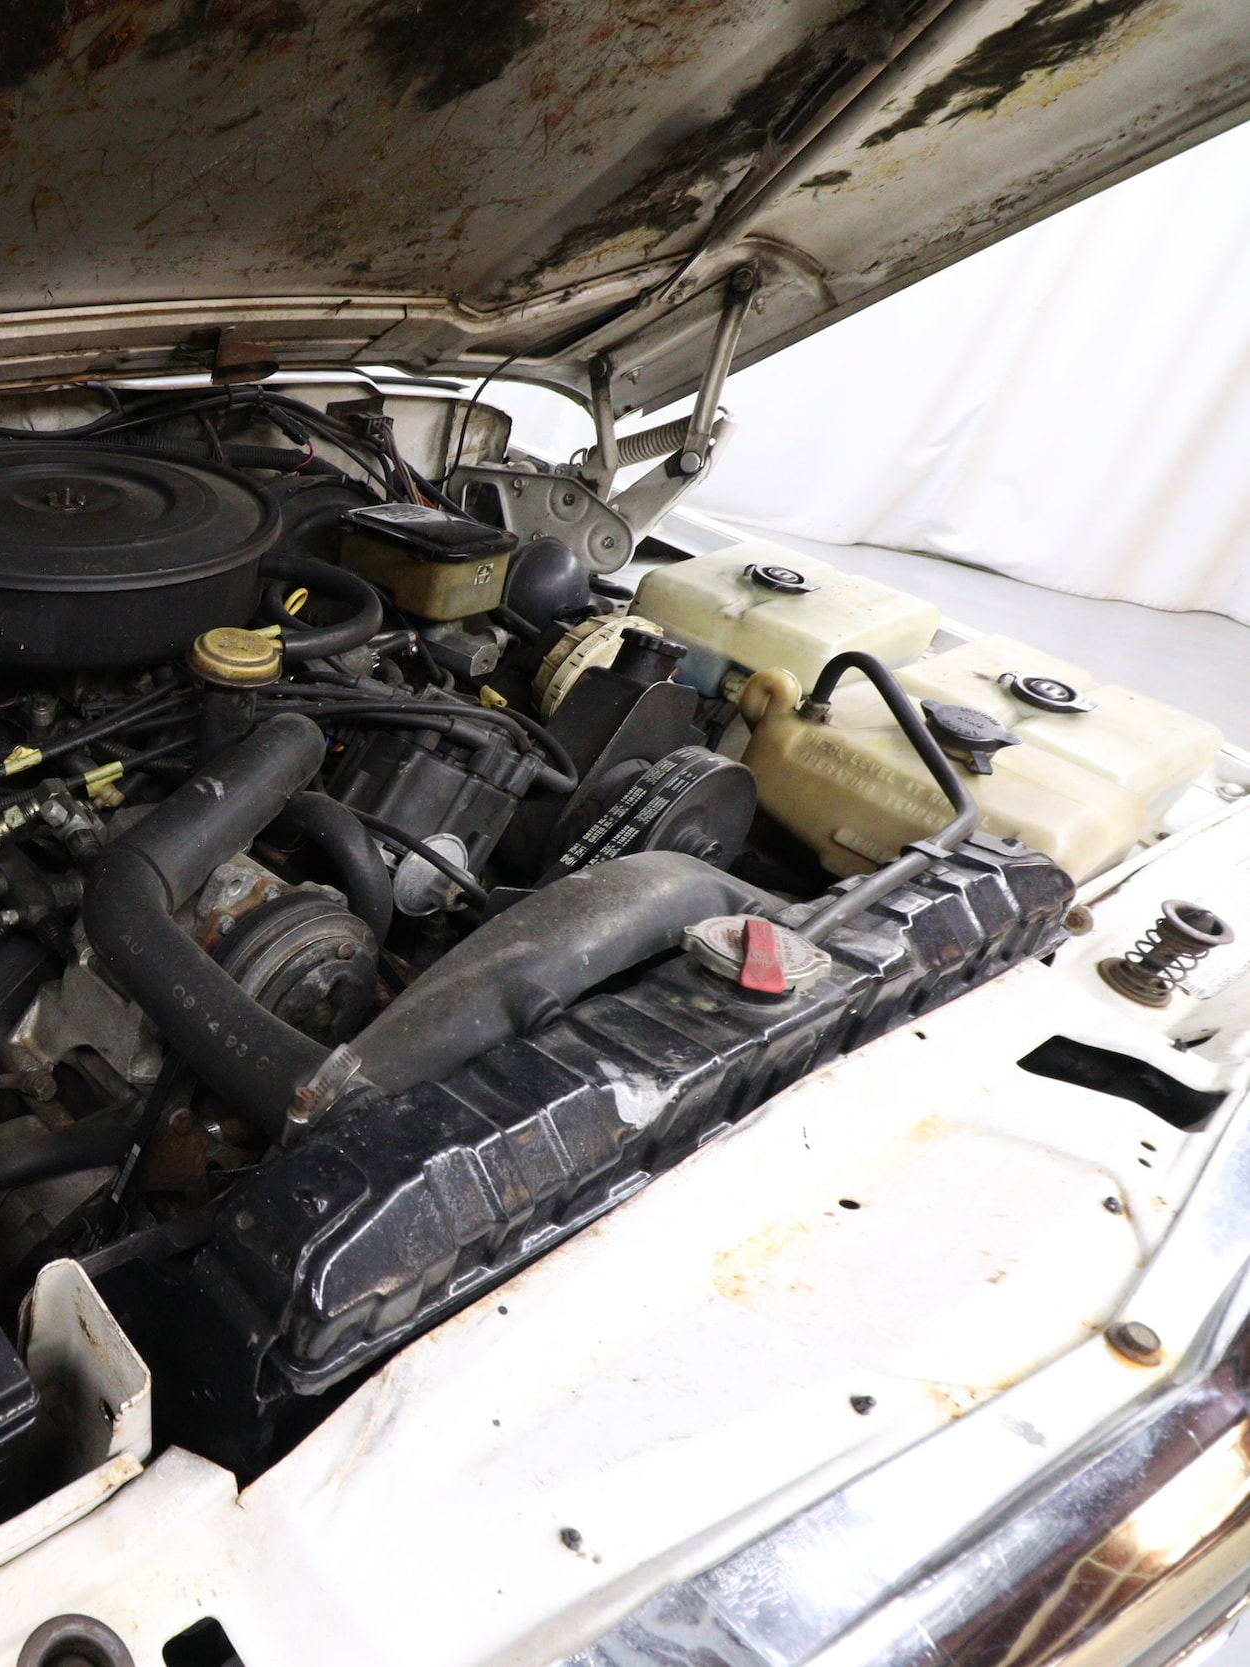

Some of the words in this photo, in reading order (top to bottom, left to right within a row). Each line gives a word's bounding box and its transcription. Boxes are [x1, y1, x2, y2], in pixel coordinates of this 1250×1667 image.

[800, 751, 877, 795] OPERATING
[850, 753, 897, 784] LEVEL
[904, 781, 927, 796] AT
[587, 826, 606, 844] GATES
[119, 934, 144, 955] AU
[172, 984, 195, 1009] 09
